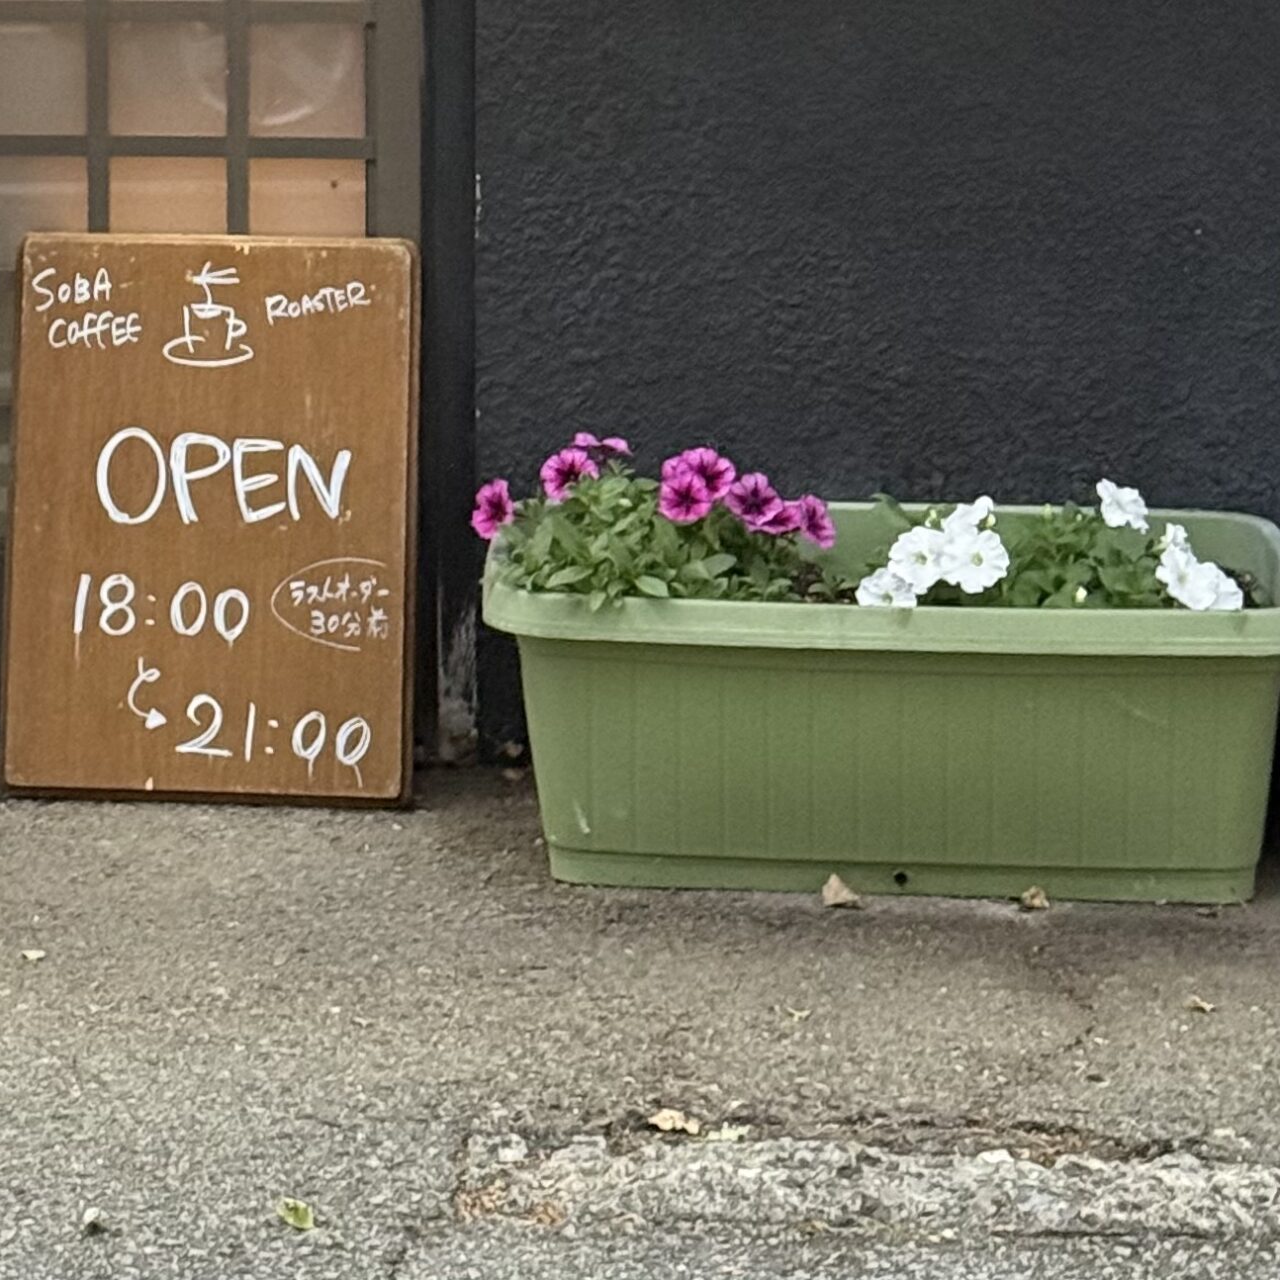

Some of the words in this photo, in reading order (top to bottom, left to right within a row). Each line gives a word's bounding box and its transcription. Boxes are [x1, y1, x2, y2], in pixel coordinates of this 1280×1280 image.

[265, 281, 371, 326] ROASTER
[96, 426, 352, 525] OPEN
[73, 572, 250, 643] 18:00
[309, 604, 388, 639] 30分前
[175, 693, 371, 768] 21:00
